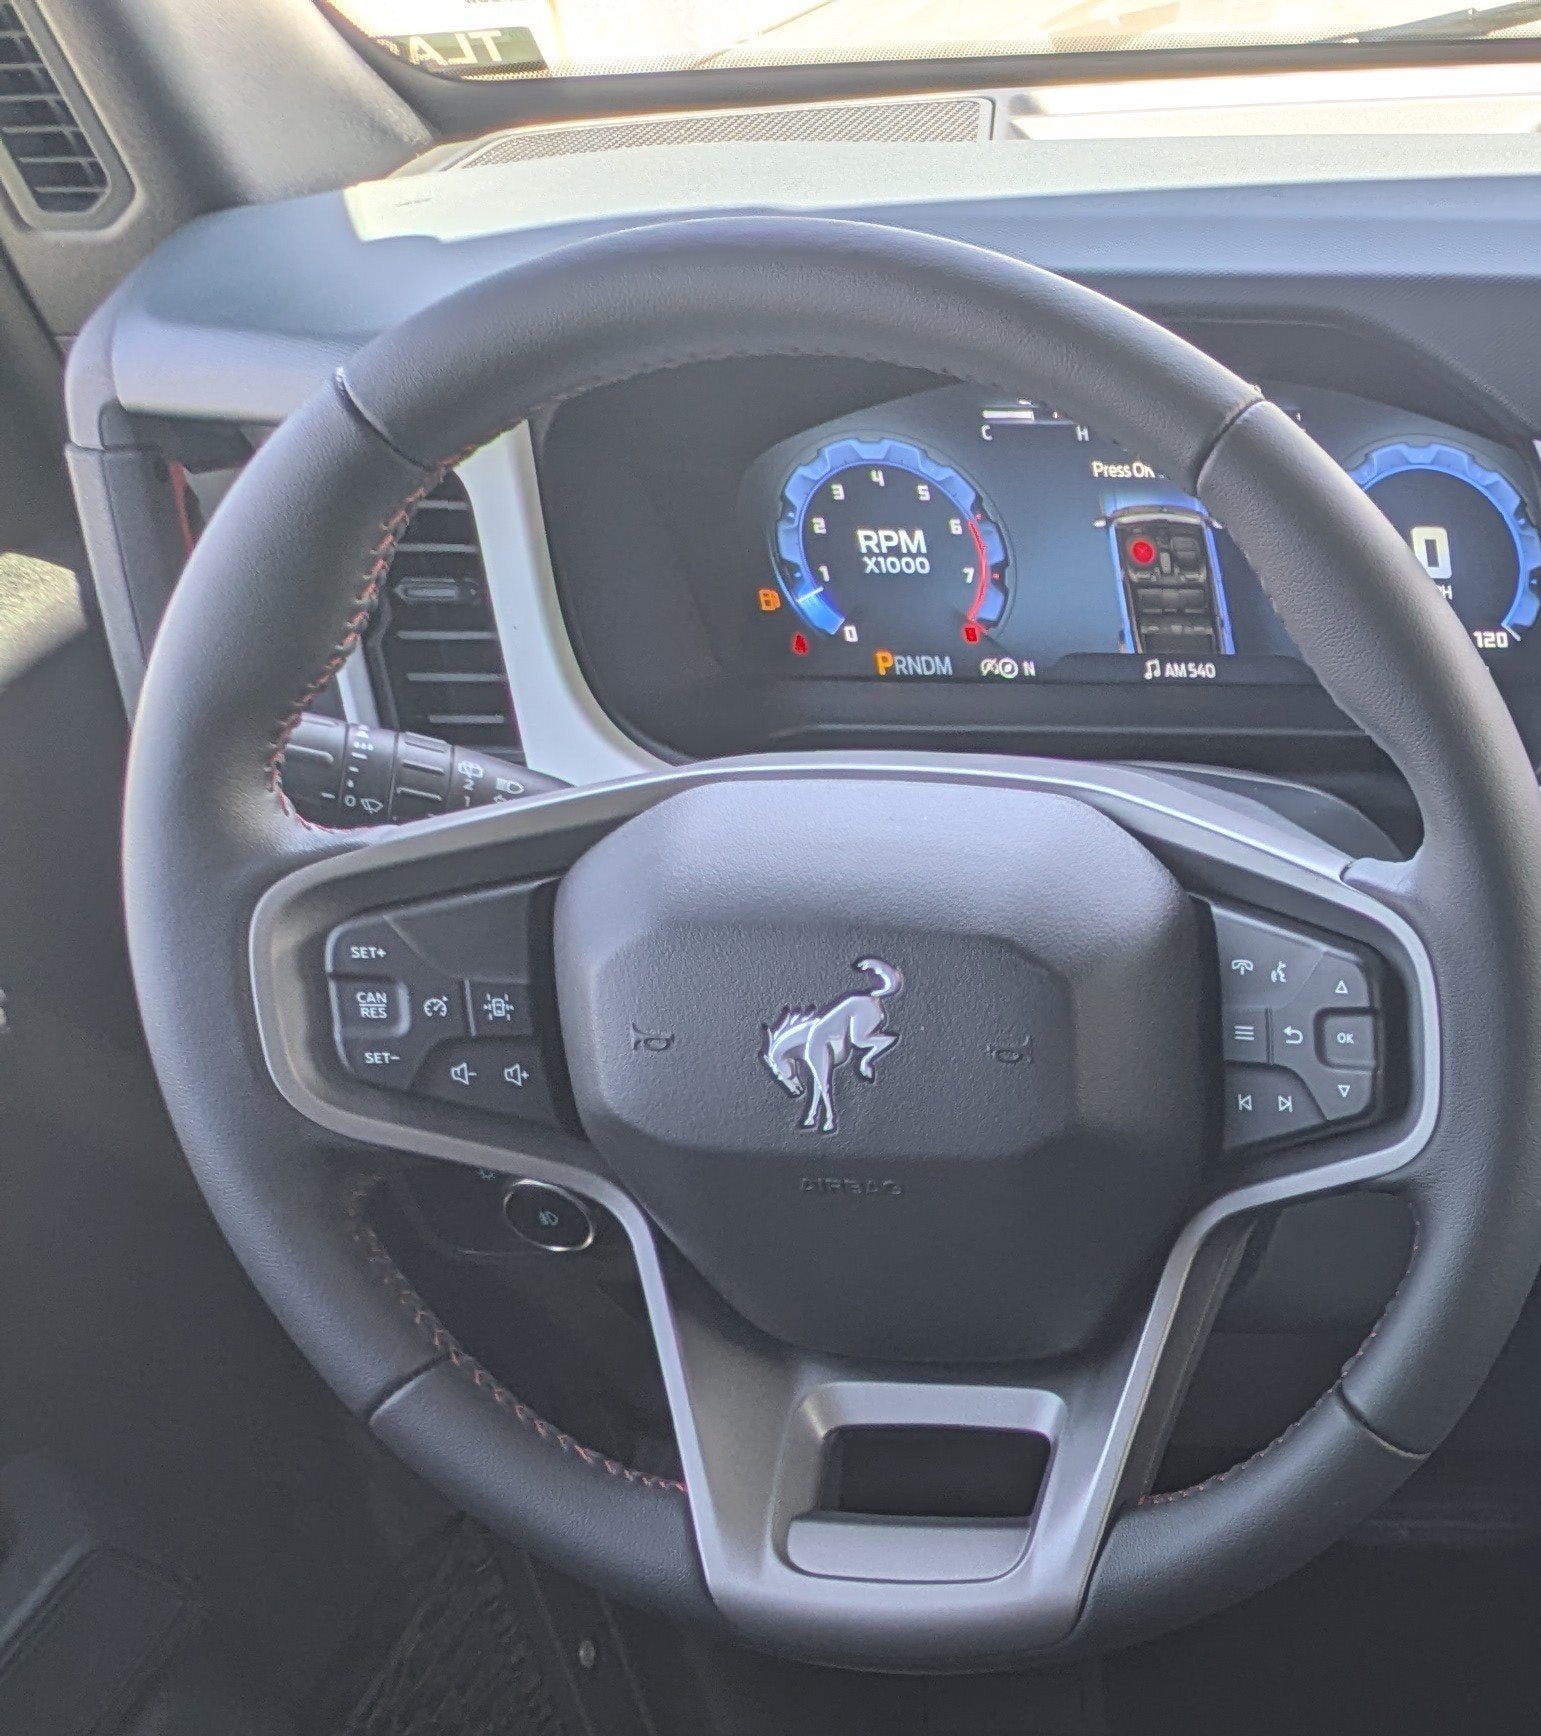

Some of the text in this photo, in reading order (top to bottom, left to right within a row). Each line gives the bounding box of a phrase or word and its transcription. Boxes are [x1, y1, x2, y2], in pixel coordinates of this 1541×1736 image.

[981, 424, 993, 441] C
[1076, 424, 1090, 441] H
[1092, 460, 1131, 478] Press
[871, 469, 885, 487] 4
[831, 483, 845, 500] 3
[917, 484, 931, 501] 5
[812, 517, 827, 534] 2
[950, 518, 963, 535] 6
[857, 529, 928, 554] RPM
[1410, 526, 1453, 579] 0
[819, 565, 830, 582] 1
[862, 556, 931, 575] X1000
[962, 566, 975, 584] 7
[844, 625, 858, 643] 0
[1474, 631, 1509, 648] 120
[1023, 661, 1036, 677] N
[350, 946, 387, 959] SET+
[356, 991, 387, 1004] CAN
[360, 1007, 388, 1019] RES
[1336, 1032, 1355, 1044] OK
